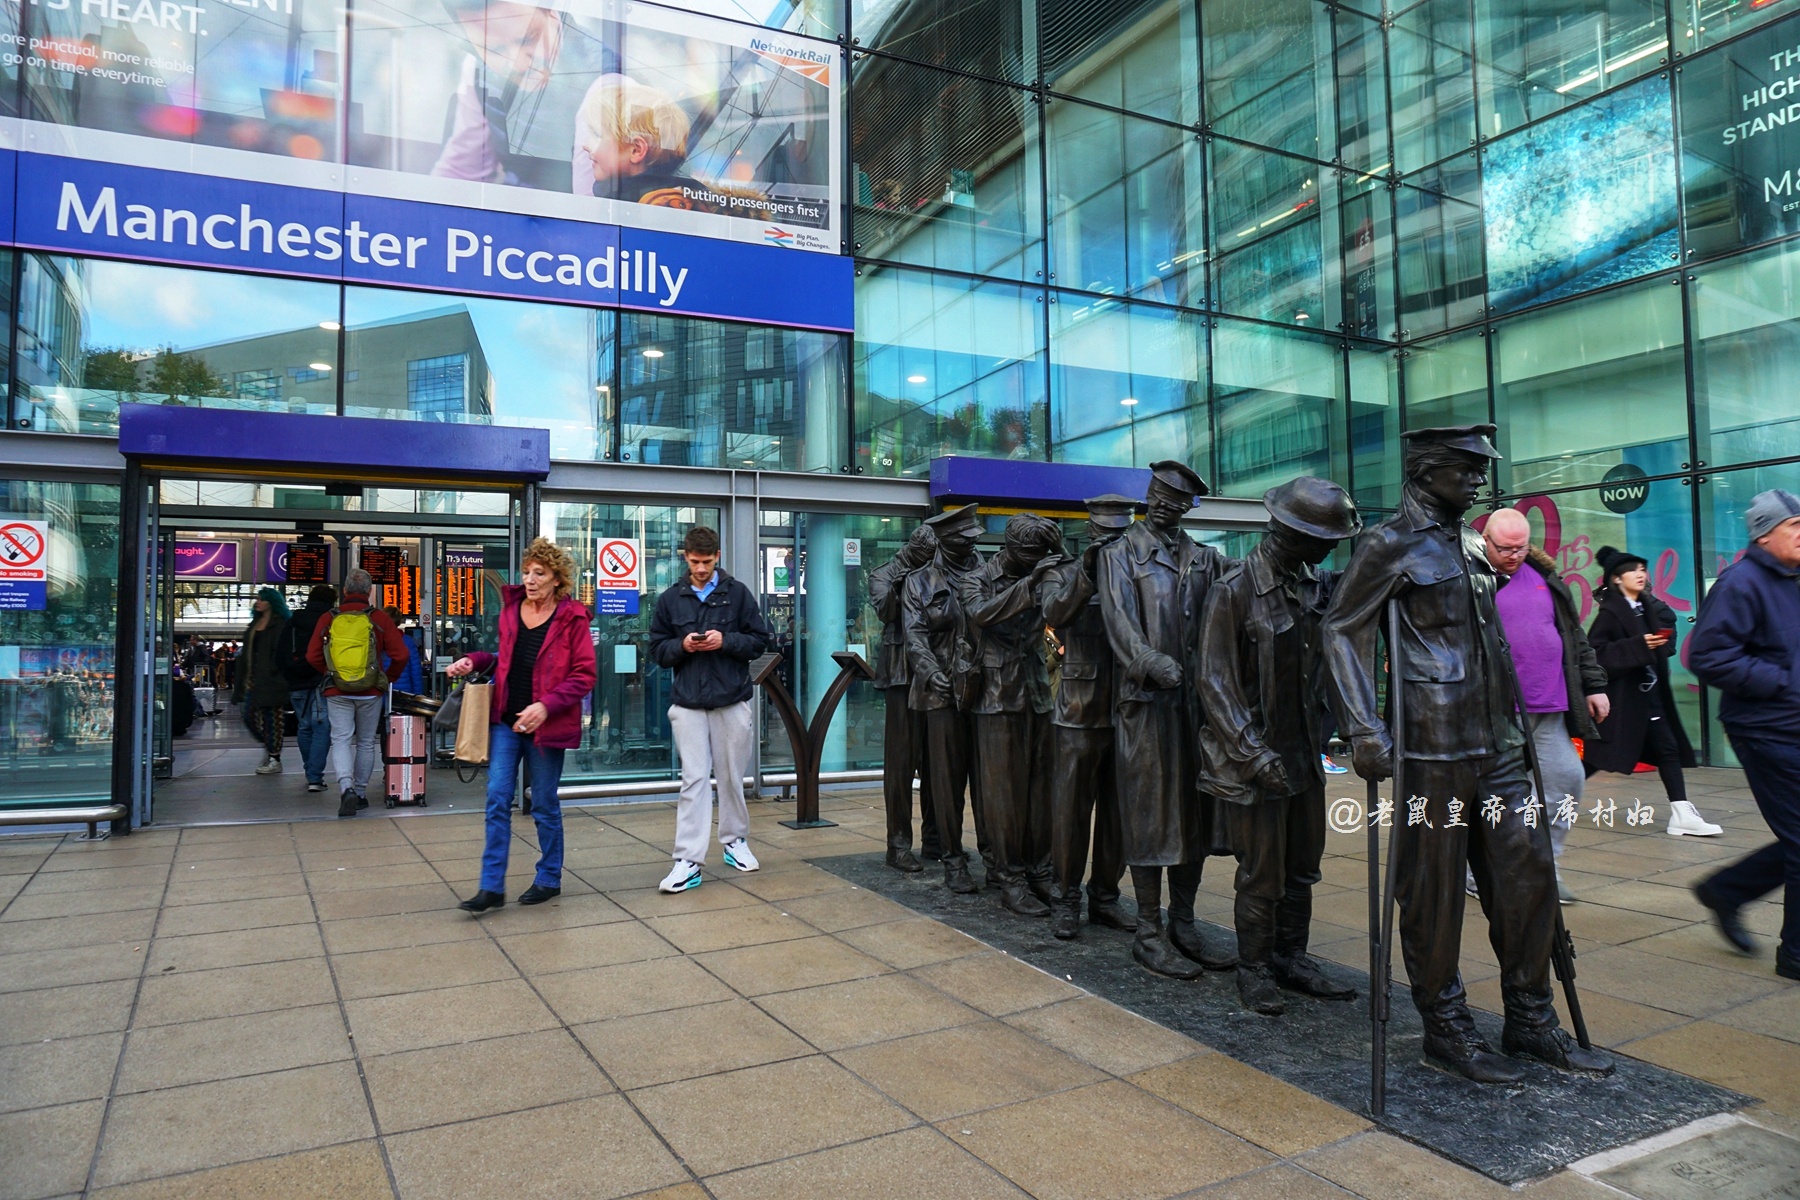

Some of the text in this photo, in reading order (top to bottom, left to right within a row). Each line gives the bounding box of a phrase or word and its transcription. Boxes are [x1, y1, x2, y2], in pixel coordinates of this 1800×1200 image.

[0, 33, 195, 75] ore punctual, more reliable
[2, 52, 167, 88] go on time, everytime.
[1764, 168, 1800, 203] M
[683, 186, 820, 218] Putting passengers first
[56, 181, 689, 307] Manchester Piccadilly
[796, 233, 806, 241] Big
[806, 241, 831, 250] Changes.
[1358, 281, 1377, 294] DEAL
[1603, 485, 1645, 502] NOW
[174, 547, 205, 557] aught.
